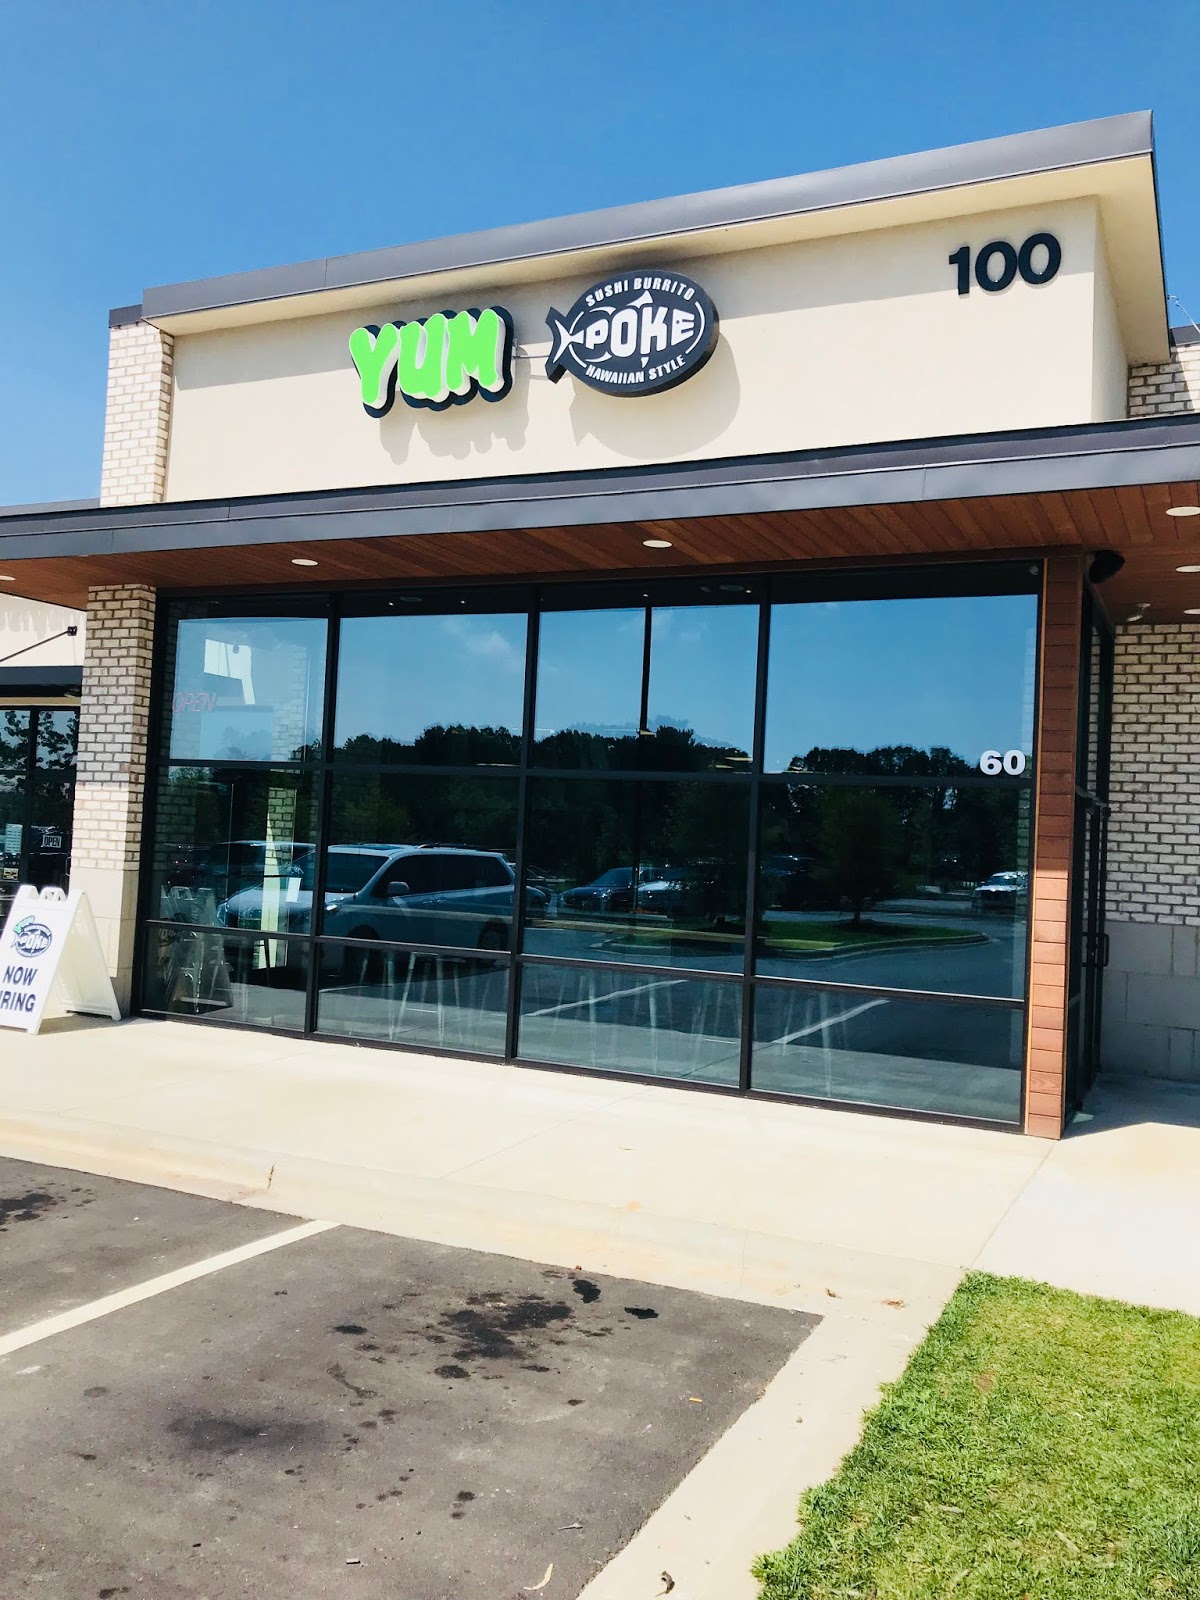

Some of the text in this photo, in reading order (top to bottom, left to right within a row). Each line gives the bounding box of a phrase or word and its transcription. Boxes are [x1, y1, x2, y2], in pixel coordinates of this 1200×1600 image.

[948, 232, 1062, 295] 100
[585, 277, 696, 307] SUSHI BURRITO
[585, 306, 695, 357] POKE
[348, 307, 511, 417] YUM
[585, 354, 686, 384] HAWAIIAN STYLE
[172, 691, 218, 713] OPEN
[979, 749, 1026, 776] 60
[44, 836, 61, 847] OPEN
[2, 965, 38, 986] NOW
